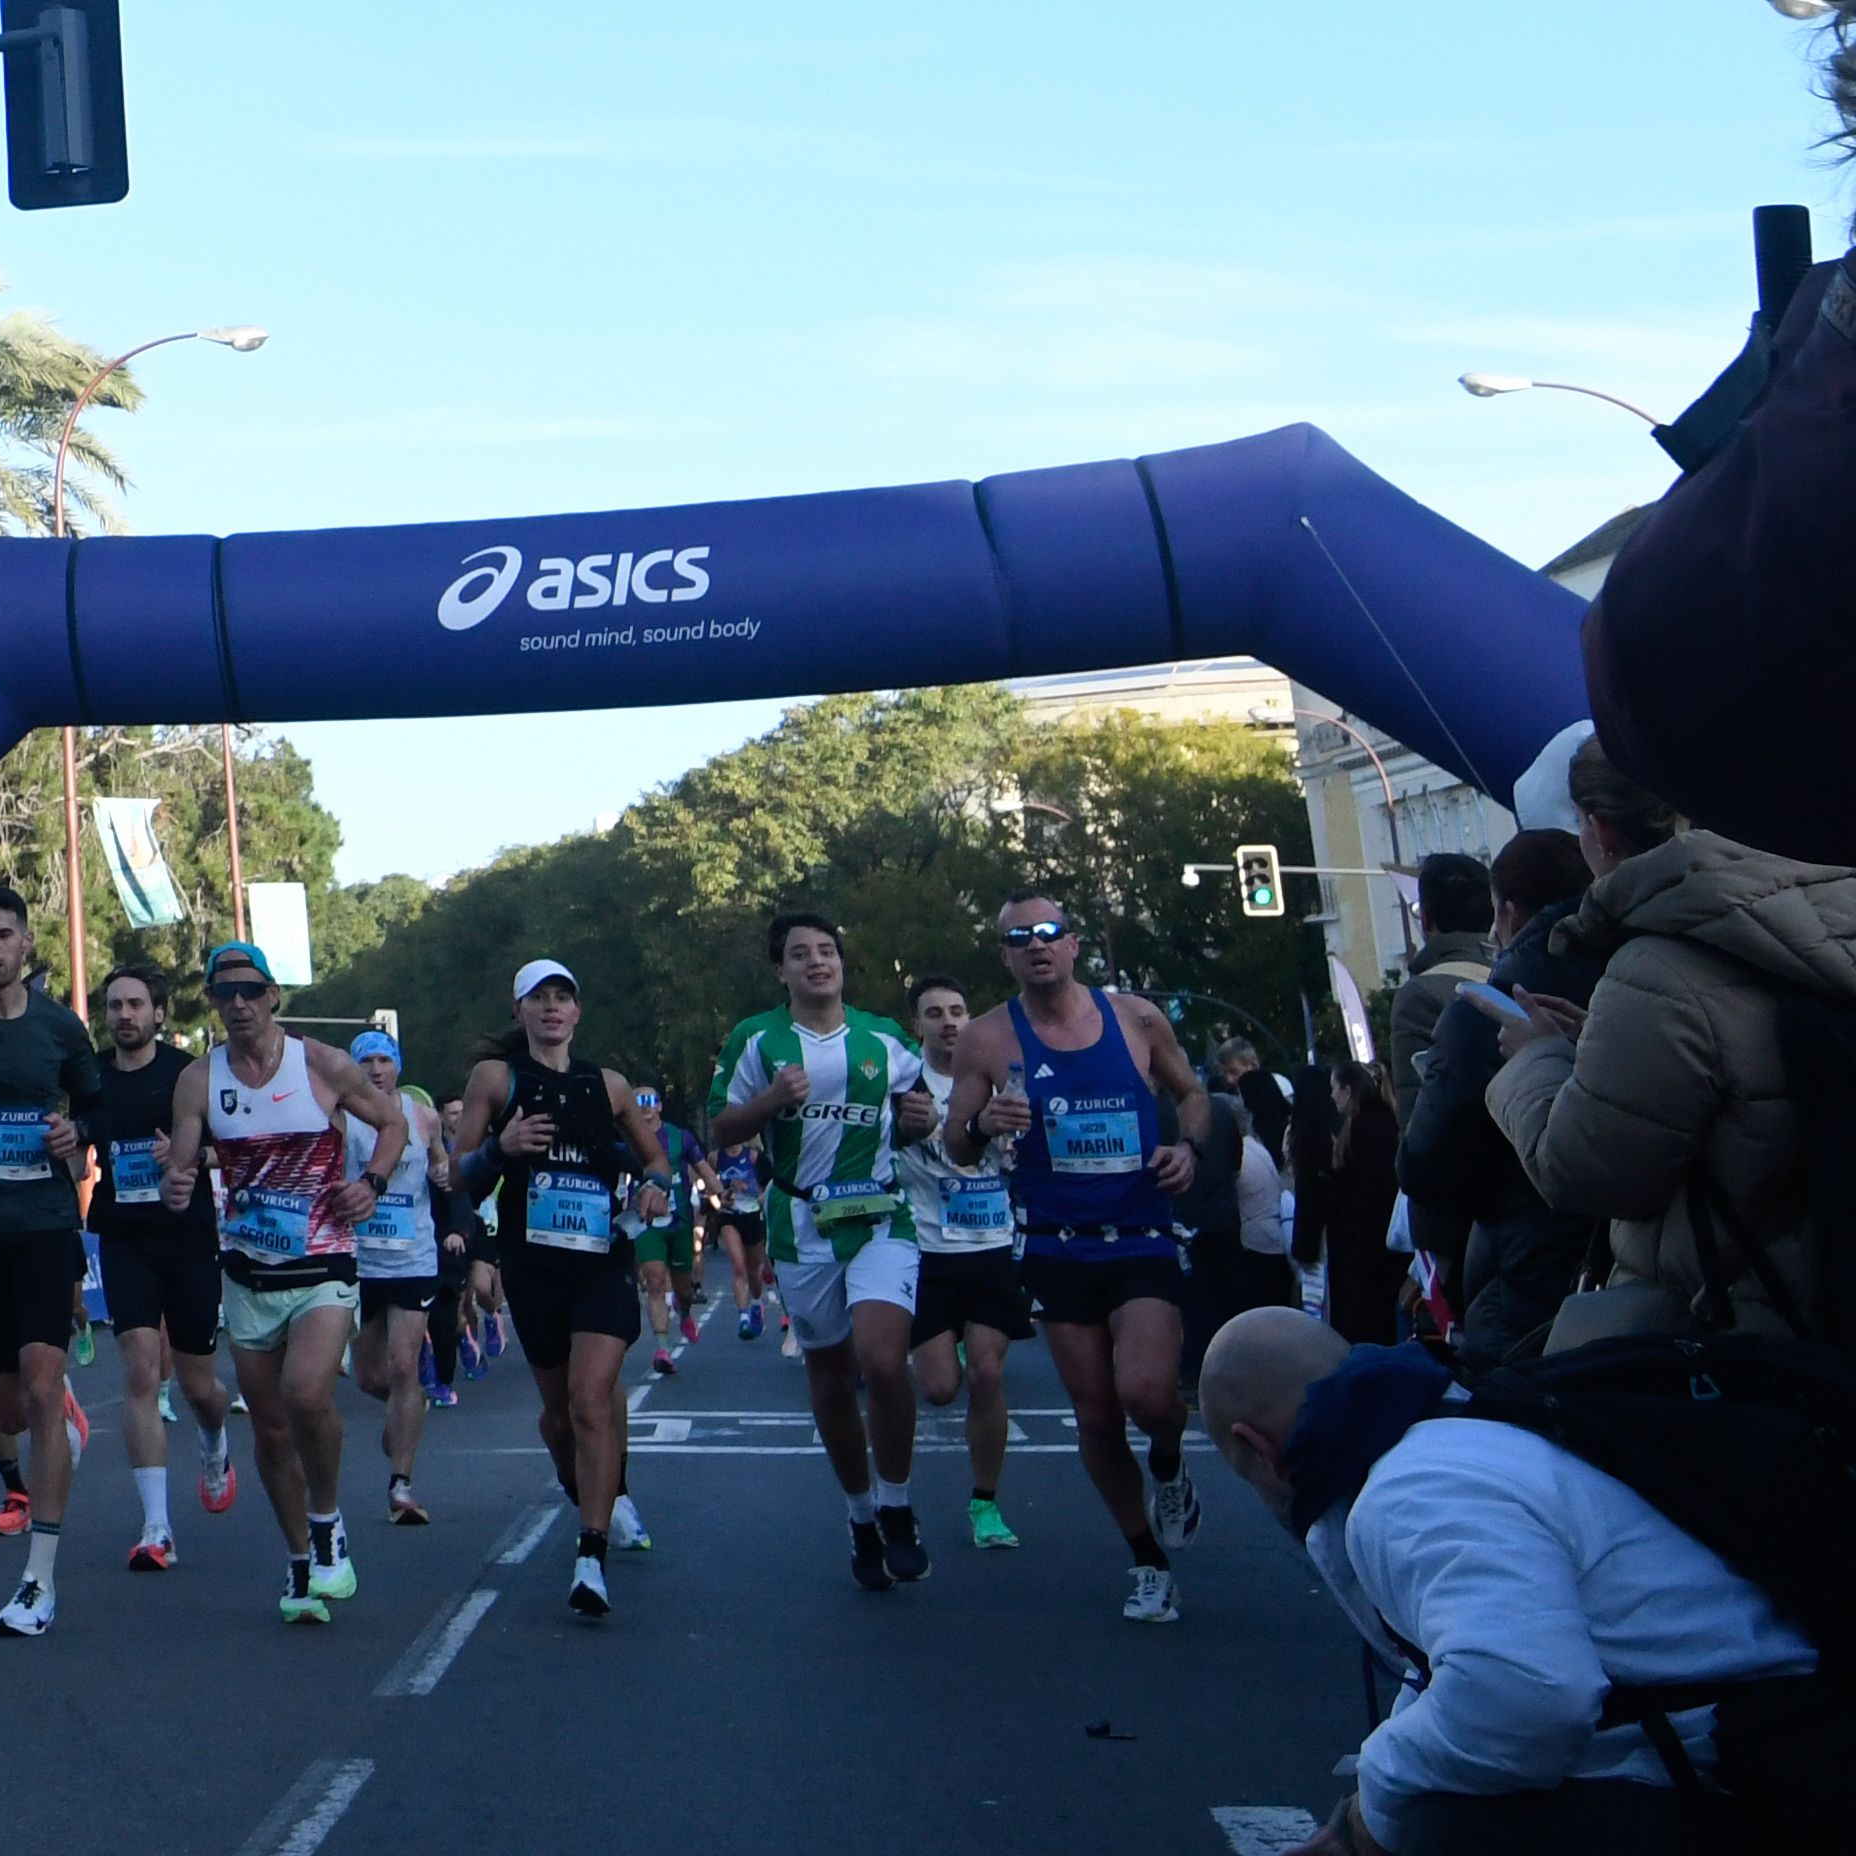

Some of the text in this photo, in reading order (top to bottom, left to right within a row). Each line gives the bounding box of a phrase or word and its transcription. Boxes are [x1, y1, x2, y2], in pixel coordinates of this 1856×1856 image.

[520, 616, 761, 651] sound mind, sound body
[1075, 1097, 1126, 1111] ZURICH
[801, 1103, 878, 1126] GREE
[124, 1140, 157, 1153] ZURIC
[548, 1142, 590, 1164] LINA
[118, 1173, 161, 1188] PABLIT
[557, 1176, 601, 1192] ZURICH
[834, 1182, 881, 1197] ZURICH
[379, 1195, 406, 1205] URICH
[552, 1213, 587, 1233] LINA
[946, 1210, 1006, 1225] MARIO 02
[368, 1223, 397, 1235] PATO
[240, 1224, 291, 1251] SERGIO
